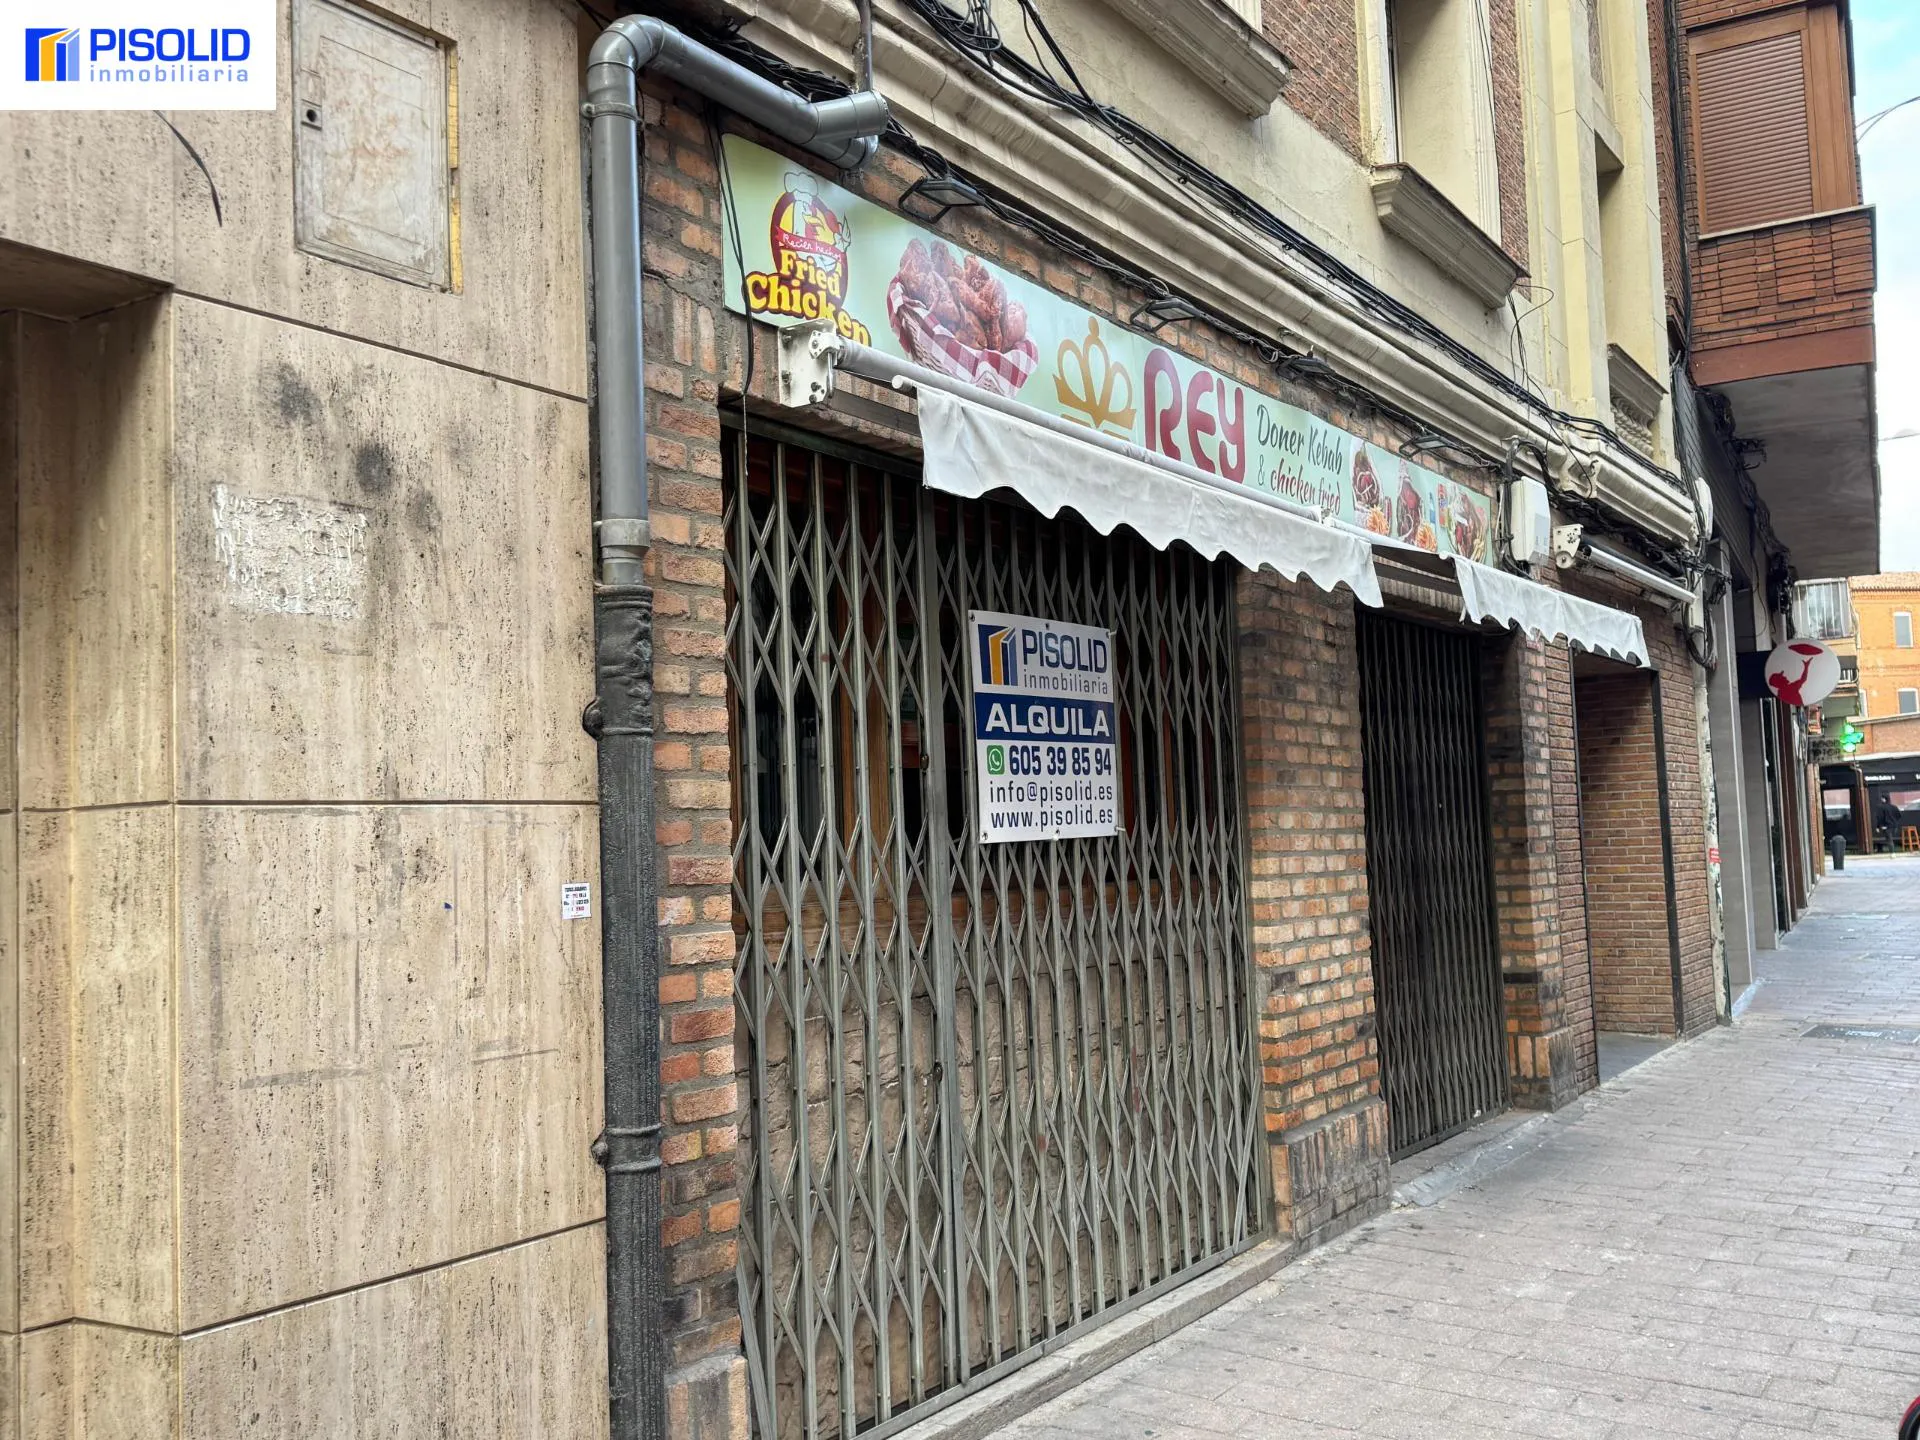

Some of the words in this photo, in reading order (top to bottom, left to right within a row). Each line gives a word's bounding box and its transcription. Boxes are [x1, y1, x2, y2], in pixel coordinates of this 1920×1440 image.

[780, 249, 842, 298] Fried
[746, 273, 870, 346] Chicken
[1256, 403, 1306, 455] Doner
[1307, 424, 1343, 475] Kebab
[1257, 454, 1266, 487] &
[1270, 459, 1316, 506] chicken
[1317, 477, 1341, 516] fried
[1021, 628, 1108, 674] PISOLID
[1023, 669, 1108, 695] inmobiliaria
[985, 702, 1110, 737] ALQUILA
[1009, 745, 1042, 776] 605
[1046, 746, 1067, 776] 39
[1072, 747, 1091, 776] 85
[1095, 748, 1111, 776] 94
[989, 780, 1113, 807] info@pisolid.es
[991, 804, 1113, 832] www.pisolid.es
